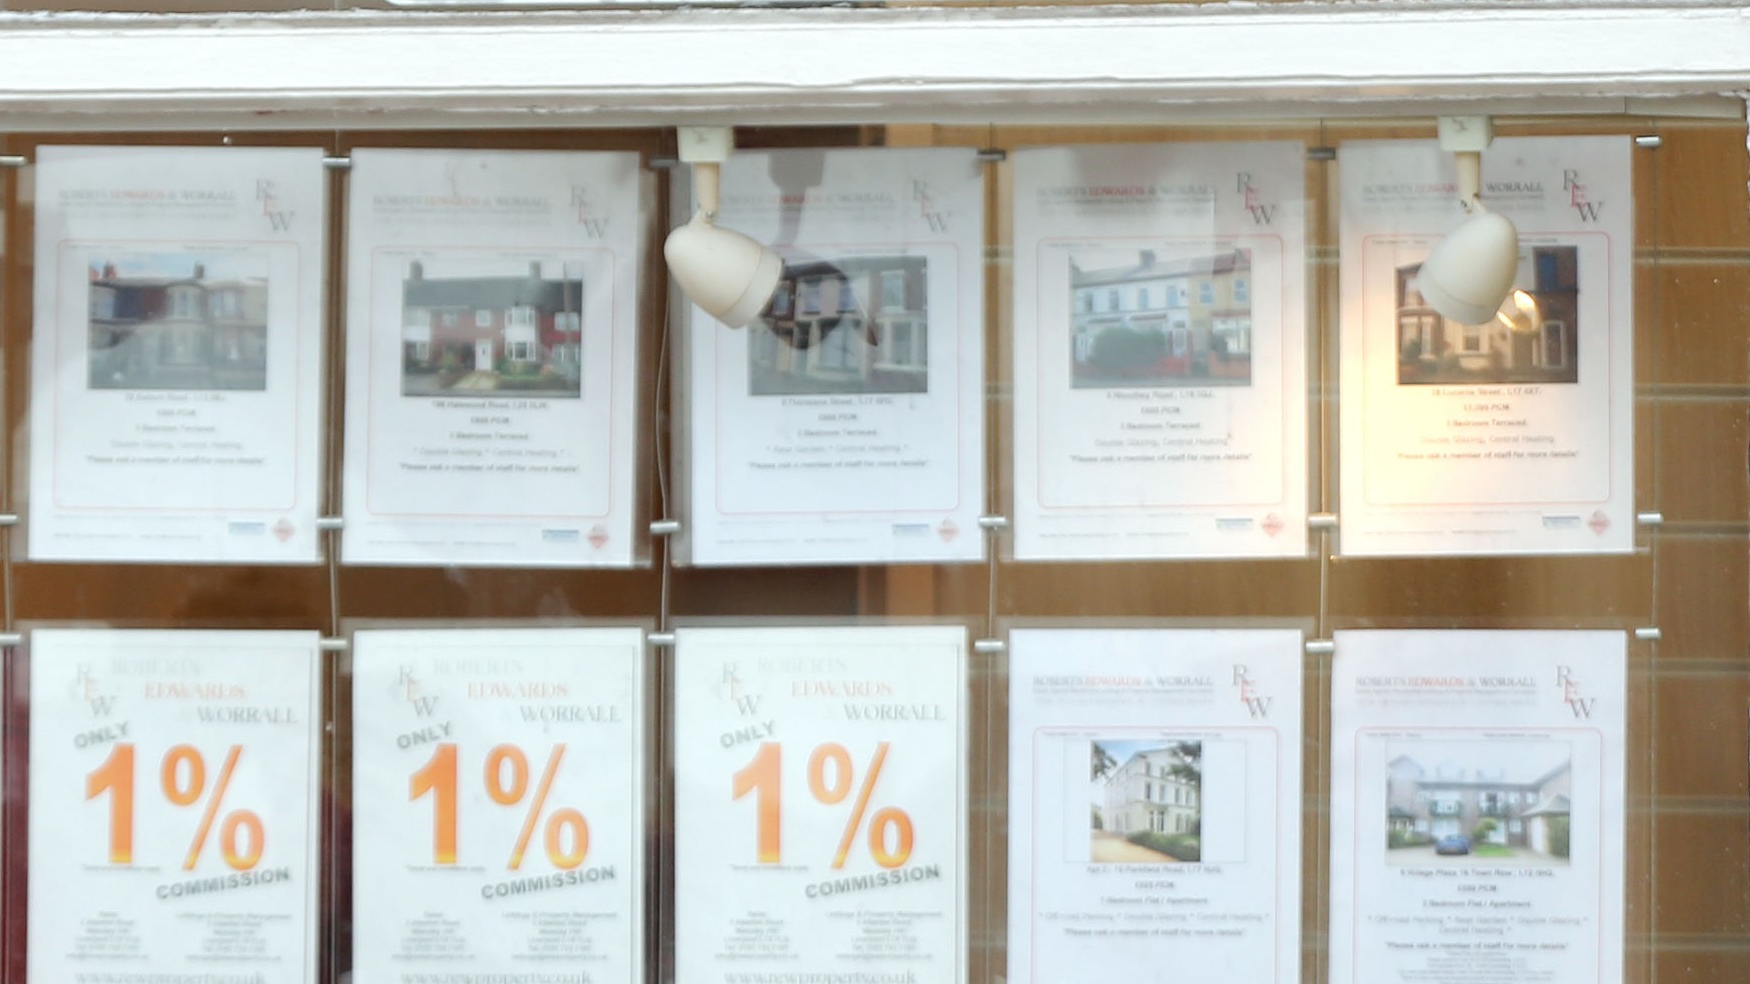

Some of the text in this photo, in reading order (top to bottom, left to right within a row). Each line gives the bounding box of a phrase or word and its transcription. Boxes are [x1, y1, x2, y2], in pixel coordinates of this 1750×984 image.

[519, 704, 621, 723] WORRALL
[843, 703, 947, 722] WORRALL
[73, 721, 130, 750] ONLY
[397, 720, 454, 750] ONLY
[719, 719, 776, 749] ONLY
[84, 742, 266, 871] 1%
[408, 742, 590, 871] 1%
[731, 741, 914, 870] 1%
[155, 865, 291, 901] COMMISSION
[481, 864, 616, 901] COMMISSION
[805, 864, 941, 899] COMMISSION
